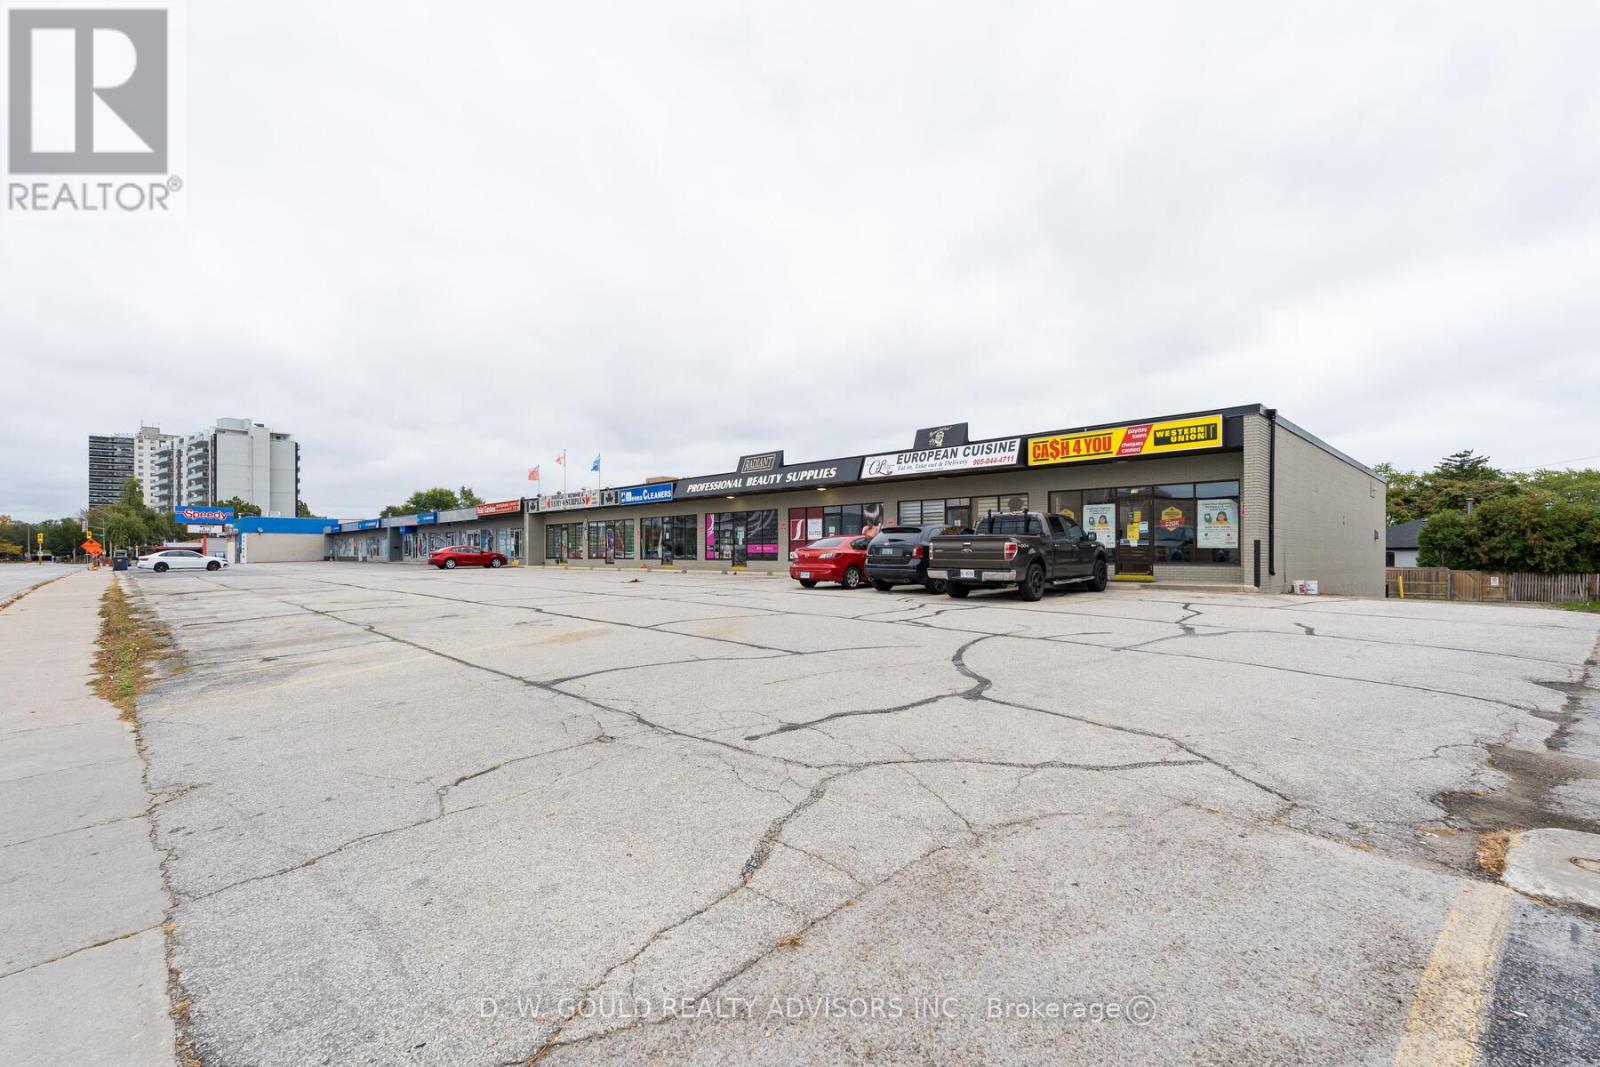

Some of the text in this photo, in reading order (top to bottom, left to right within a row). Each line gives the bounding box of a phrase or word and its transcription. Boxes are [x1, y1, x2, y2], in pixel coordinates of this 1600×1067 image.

[1155, 425, 1205, 438] WESTERN
[1170, 433, 1205, 443] UNION
[896, 440, 1017, 465] EUROPEAN CUISINE
[1073, 440, 1081, 455] 4
[1084, 435, 1112, 453] YOU
[686, 467, 838, 493] PROFESSIONAL BEAUTY SUPPLIES
[182, 509, 228, 520] Speedy
